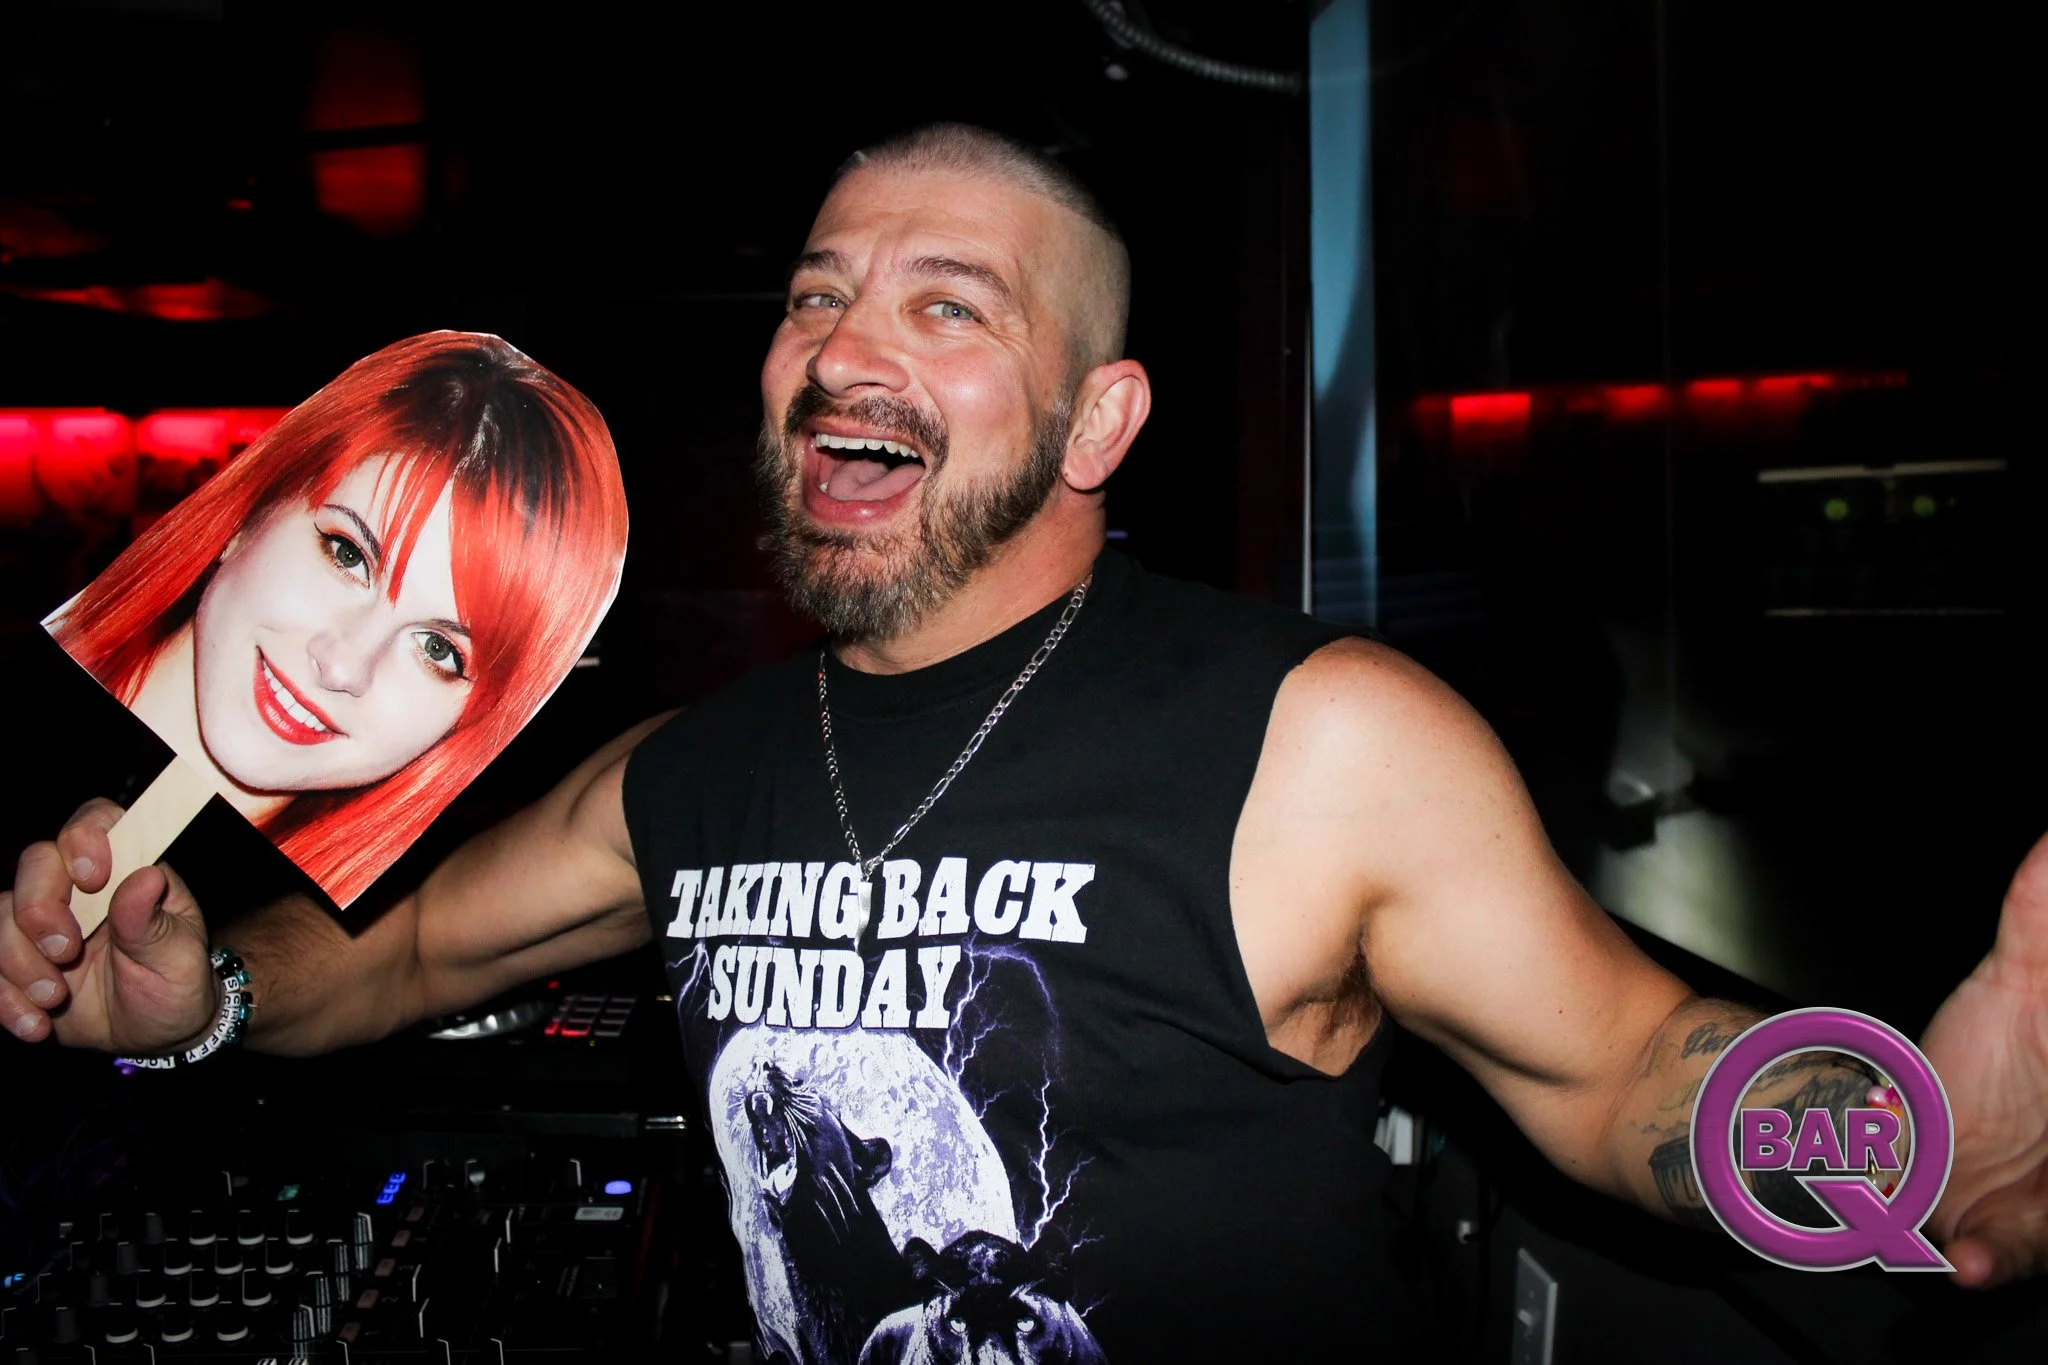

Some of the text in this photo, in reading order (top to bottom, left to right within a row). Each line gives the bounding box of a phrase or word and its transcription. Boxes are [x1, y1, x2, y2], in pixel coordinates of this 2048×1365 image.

[666, 857, 1096, 943] TAKING BACK
[707, 945, 962, 1029] SUNDAY
